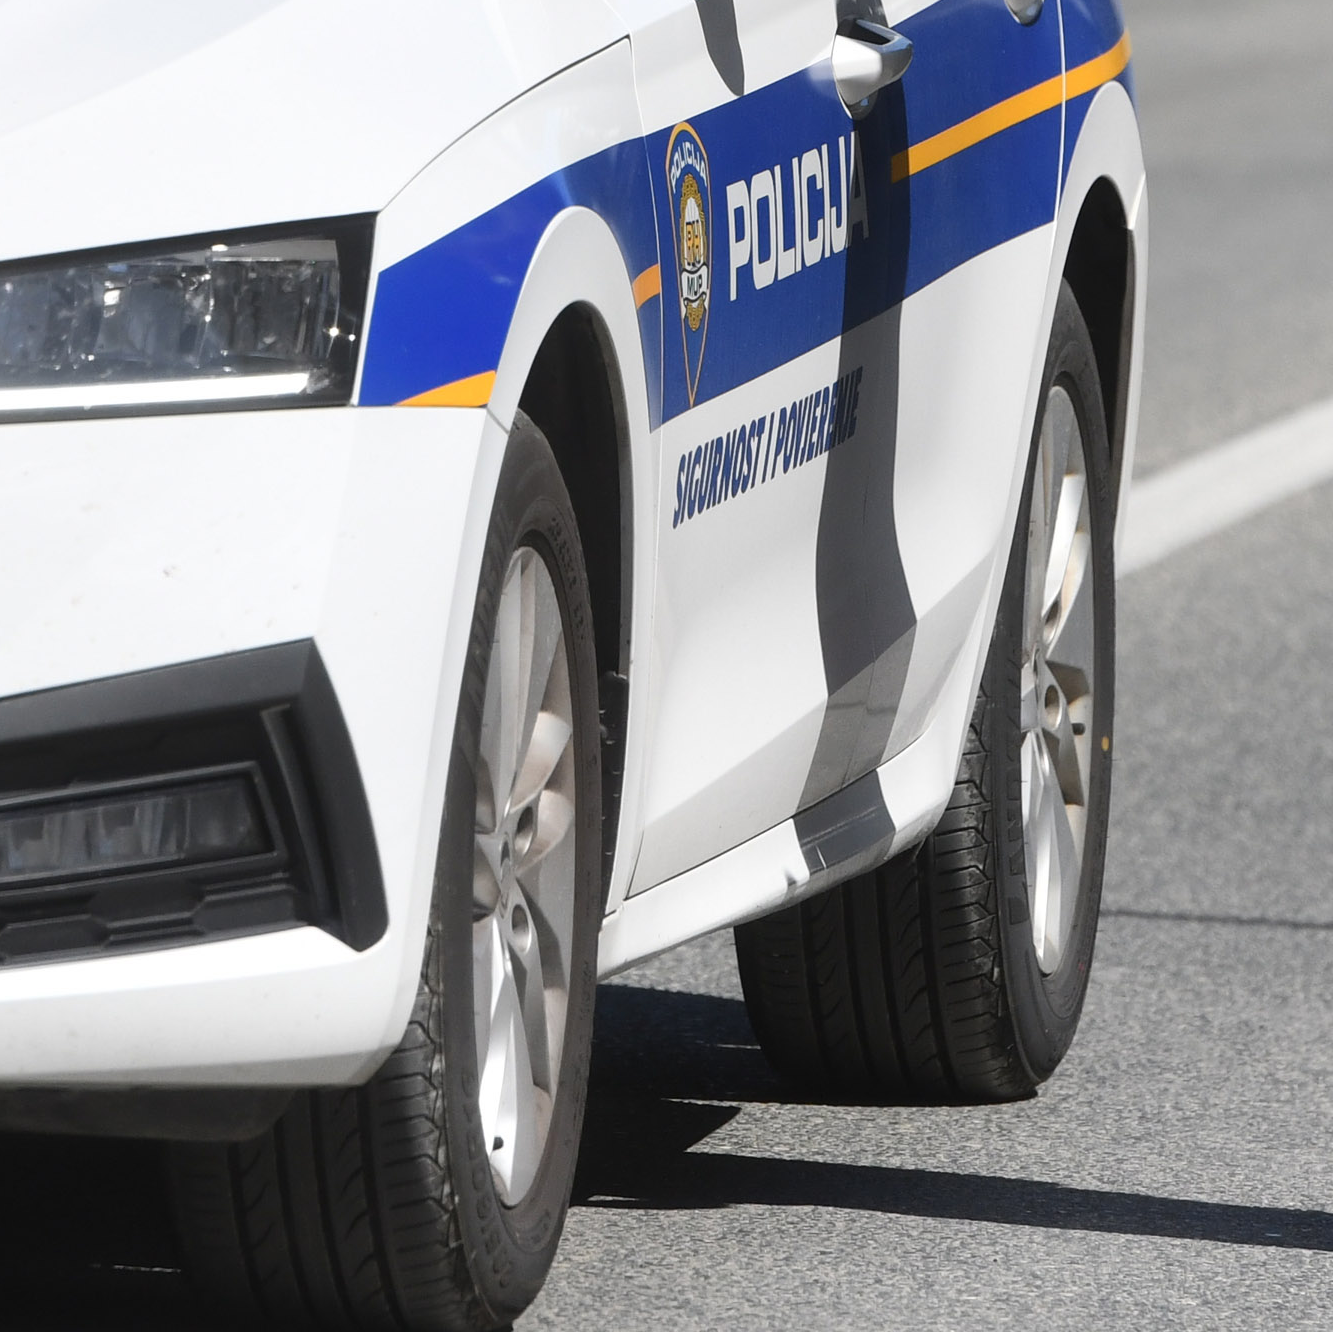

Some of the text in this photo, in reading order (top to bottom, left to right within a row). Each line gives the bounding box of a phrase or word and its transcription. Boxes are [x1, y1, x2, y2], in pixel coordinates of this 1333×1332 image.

[671, 141, 708, 194] POLICIJA
[726, 131, 870, 301] POLICIJA
[687, 275, 703, 298] MUP
[672, 366, 864, 529] SIGURNOST I POVJERENJE
